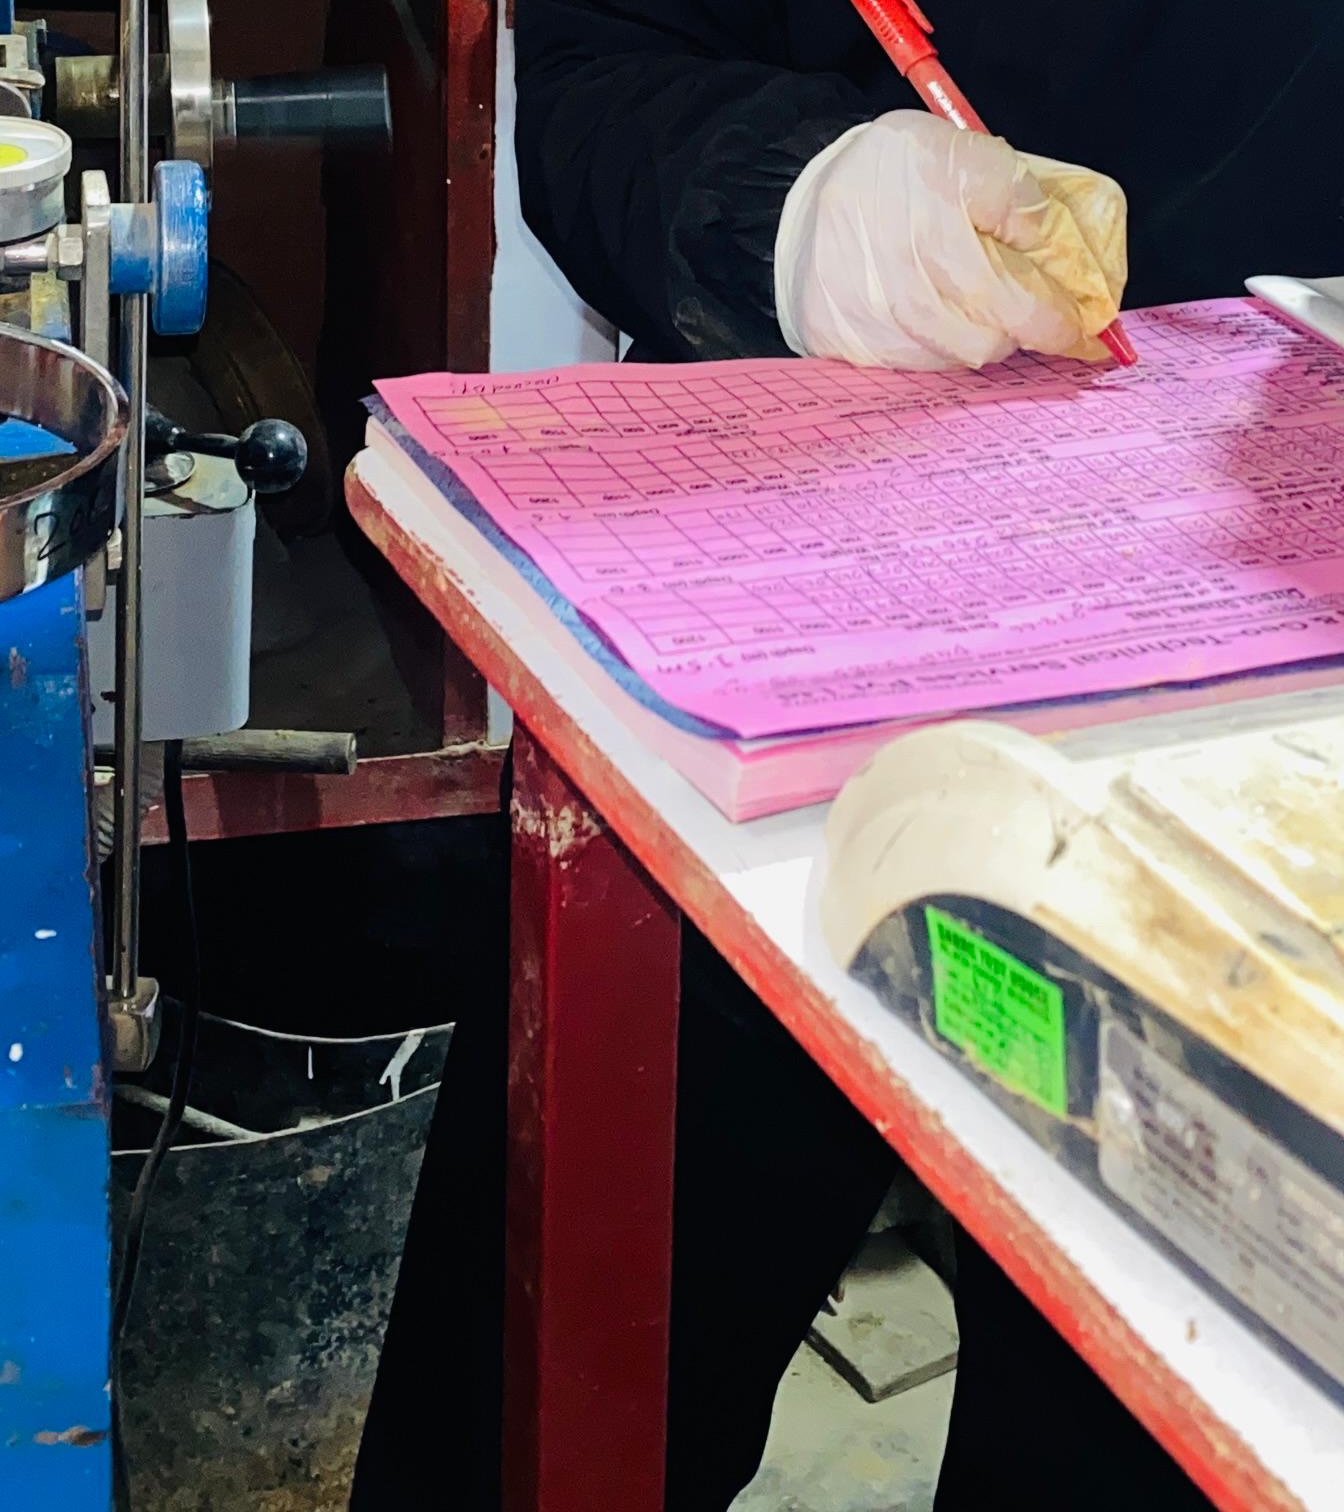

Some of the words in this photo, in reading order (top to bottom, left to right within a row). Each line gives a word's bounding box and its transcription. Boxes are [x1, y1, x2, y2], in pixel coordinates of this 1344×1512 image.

[1241, 588, 1306, 605] Direct
[1128, 607, 1172, 622] Test
[1178, 598, 1239, 615] Shear
[1065, 618, 1311, 665] Geo-Technical
